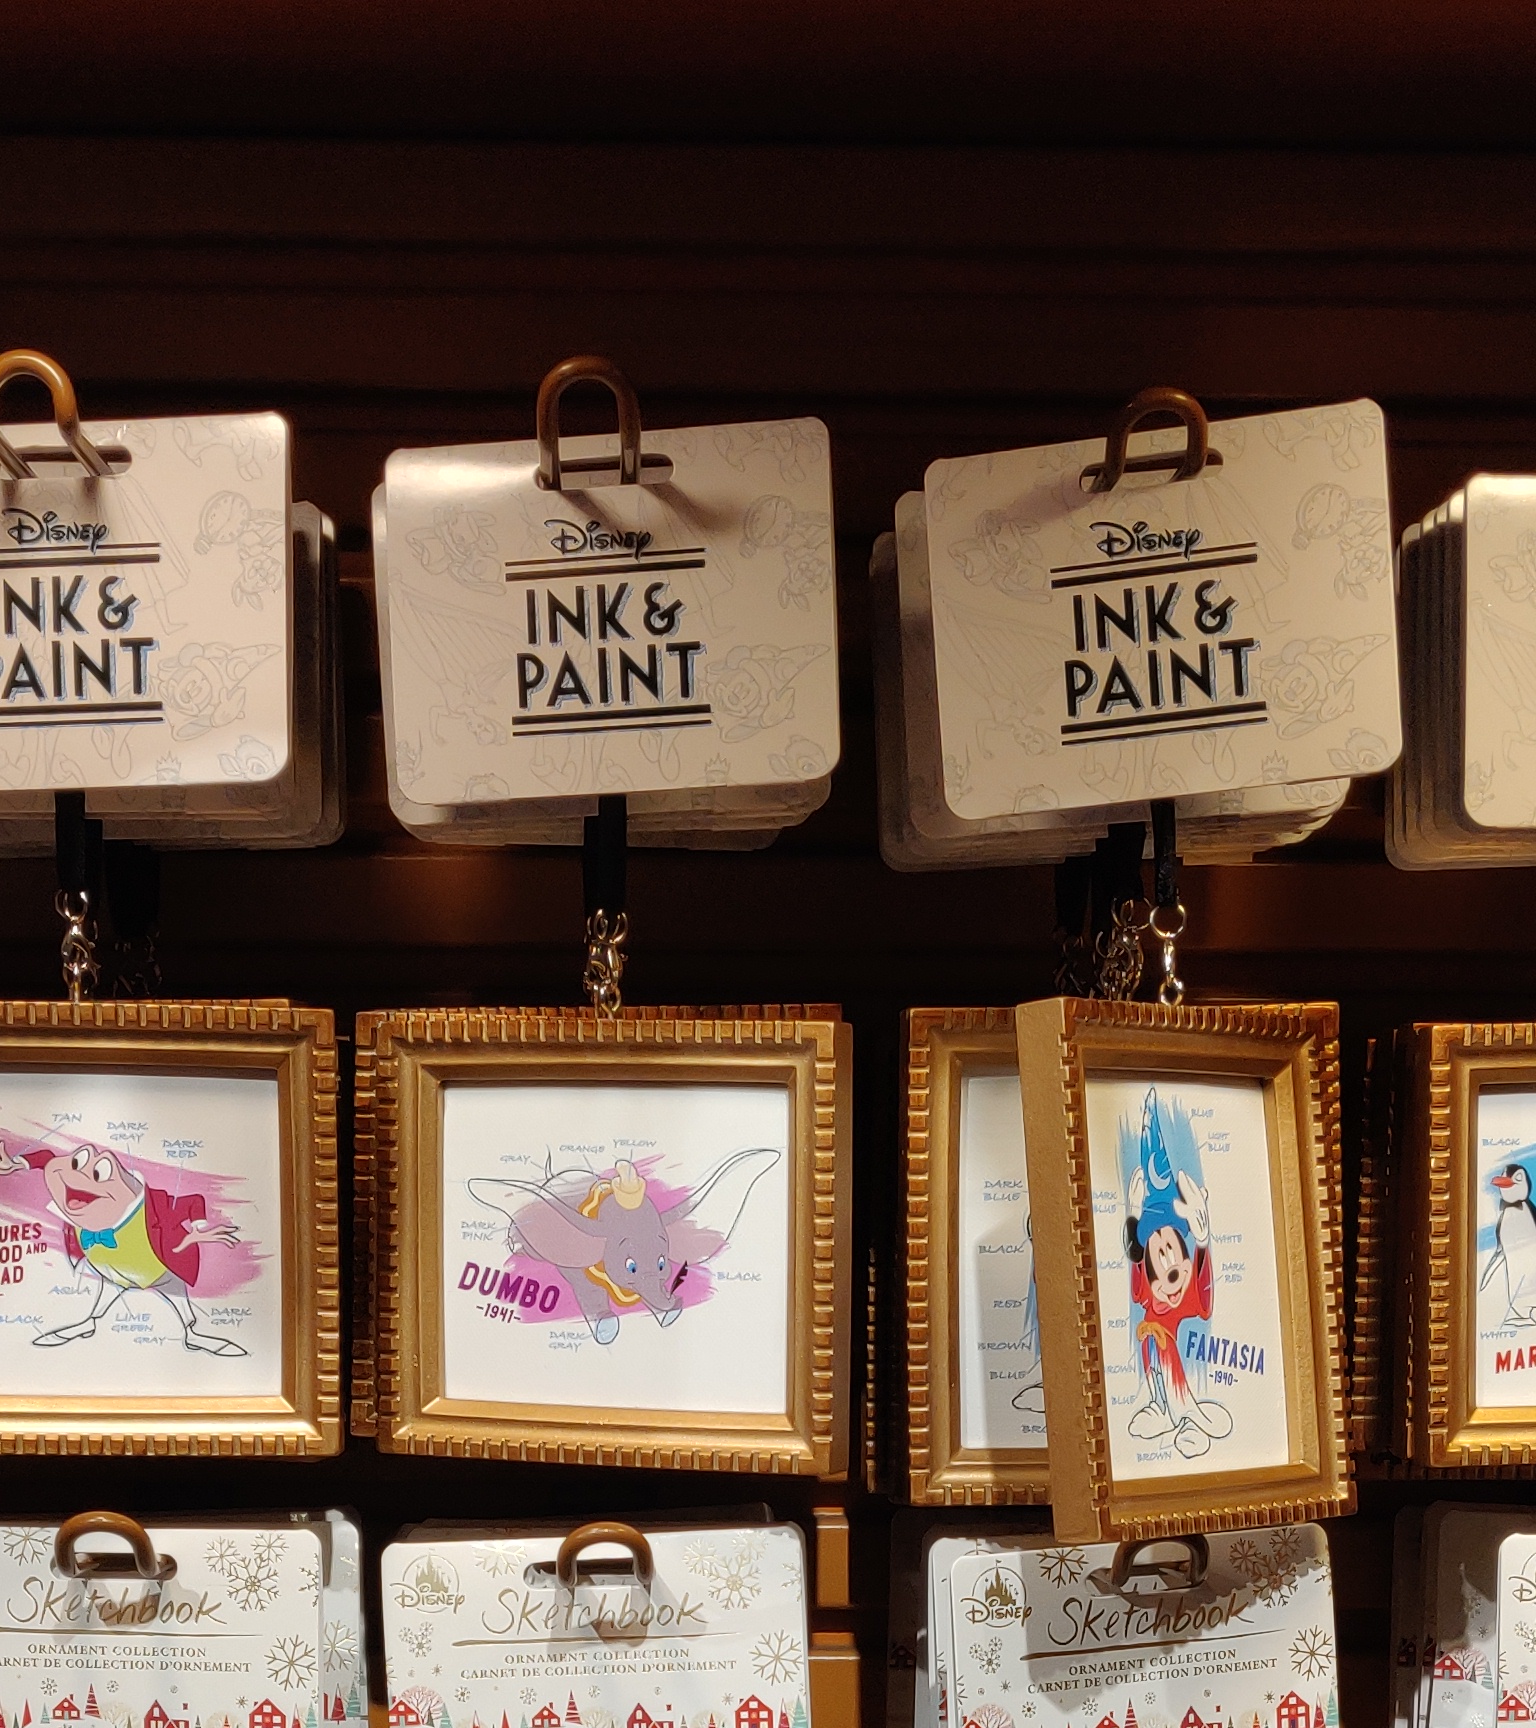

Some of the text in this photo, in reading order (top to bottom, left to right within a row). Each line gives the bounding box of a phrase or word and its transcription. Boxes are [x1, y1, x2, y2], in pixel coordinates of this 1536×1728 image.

[98, 576, 141, 632] &
[526, 582, 687, 647] INK &
[1073, 579, 1239, 652] INK &
[517, 641, 707, 711] PAINT
[1065, 638, 1261, 719] PAINT
[106, 1121, 148, 1131] DARK
[110, 1132, 144, 1142] GRAY
[162, 1139, 204, 1149] DARK
[166, 1149, 197, 1158] RED
[500, 1154, 530, 1164] GRAY
[984, 1179, 1023, 1189] DARK
[983, 1192, 1020, 1202] BLUE
[461, 1221, 497, 1230] DARK
[462, 1232, 493, 1241] PINK
[26, 1242, 47, 1254] AND
[978, 1244, 1024, 1254] BLACK
[458, 1261, 560, 1314] DUMBO
[993, 1300, 1022, 1308] RED
[210, 1308, 252, 1316] DARK
[211, 1317, 243, 1327] GRAY
[133, 1335, 166, 1346] GRAY
[550, 1331, 586, 1340] DARK
[549, 1341, 582, 1352] GRAY
[1186, 1330, 1264, 1375] FANTASIA
[989, 1370, 1026, 1380] BLUE
[6, 1576, 228, 1626] Sketchbook
[481, 1588, 709, 1635] Sketchbook
[1048, 1593, 1255, 1646] Sketchbook
[1068, 1649, 1237, 1677] ORNAMENT COLLECTION
[1027, 1658, 1278, 1694] CARNET DE COLLECTION D'ORNEMENT
